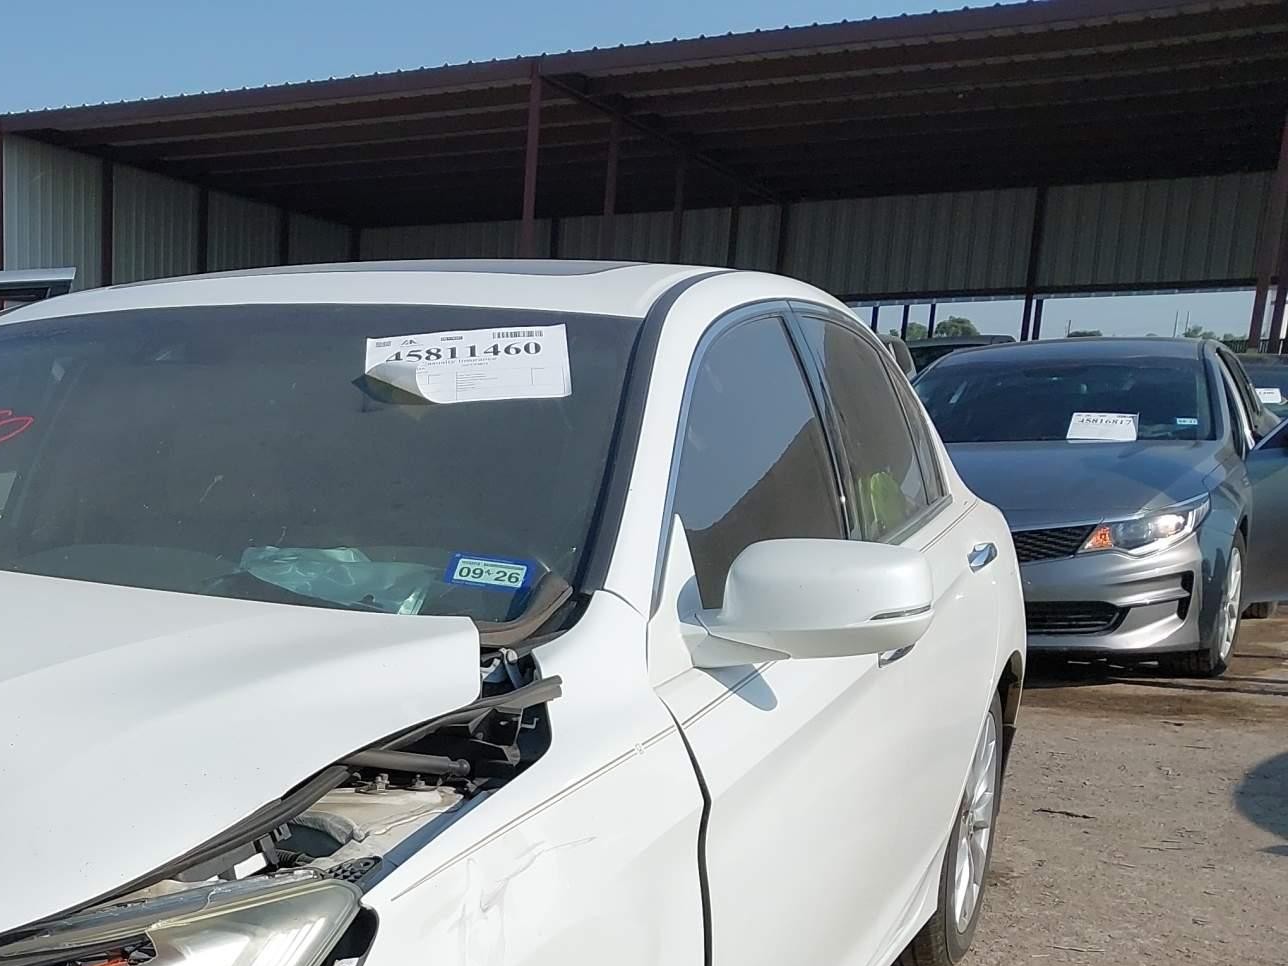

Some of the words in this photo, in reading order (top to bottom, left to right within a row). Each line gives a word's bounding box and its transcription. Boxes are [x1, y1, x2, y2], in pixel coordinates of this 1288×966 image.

[385, 341, 542, 363] 45811460
[458, 566, 484, 579] 09
[494, 570, 521, 584] 26
